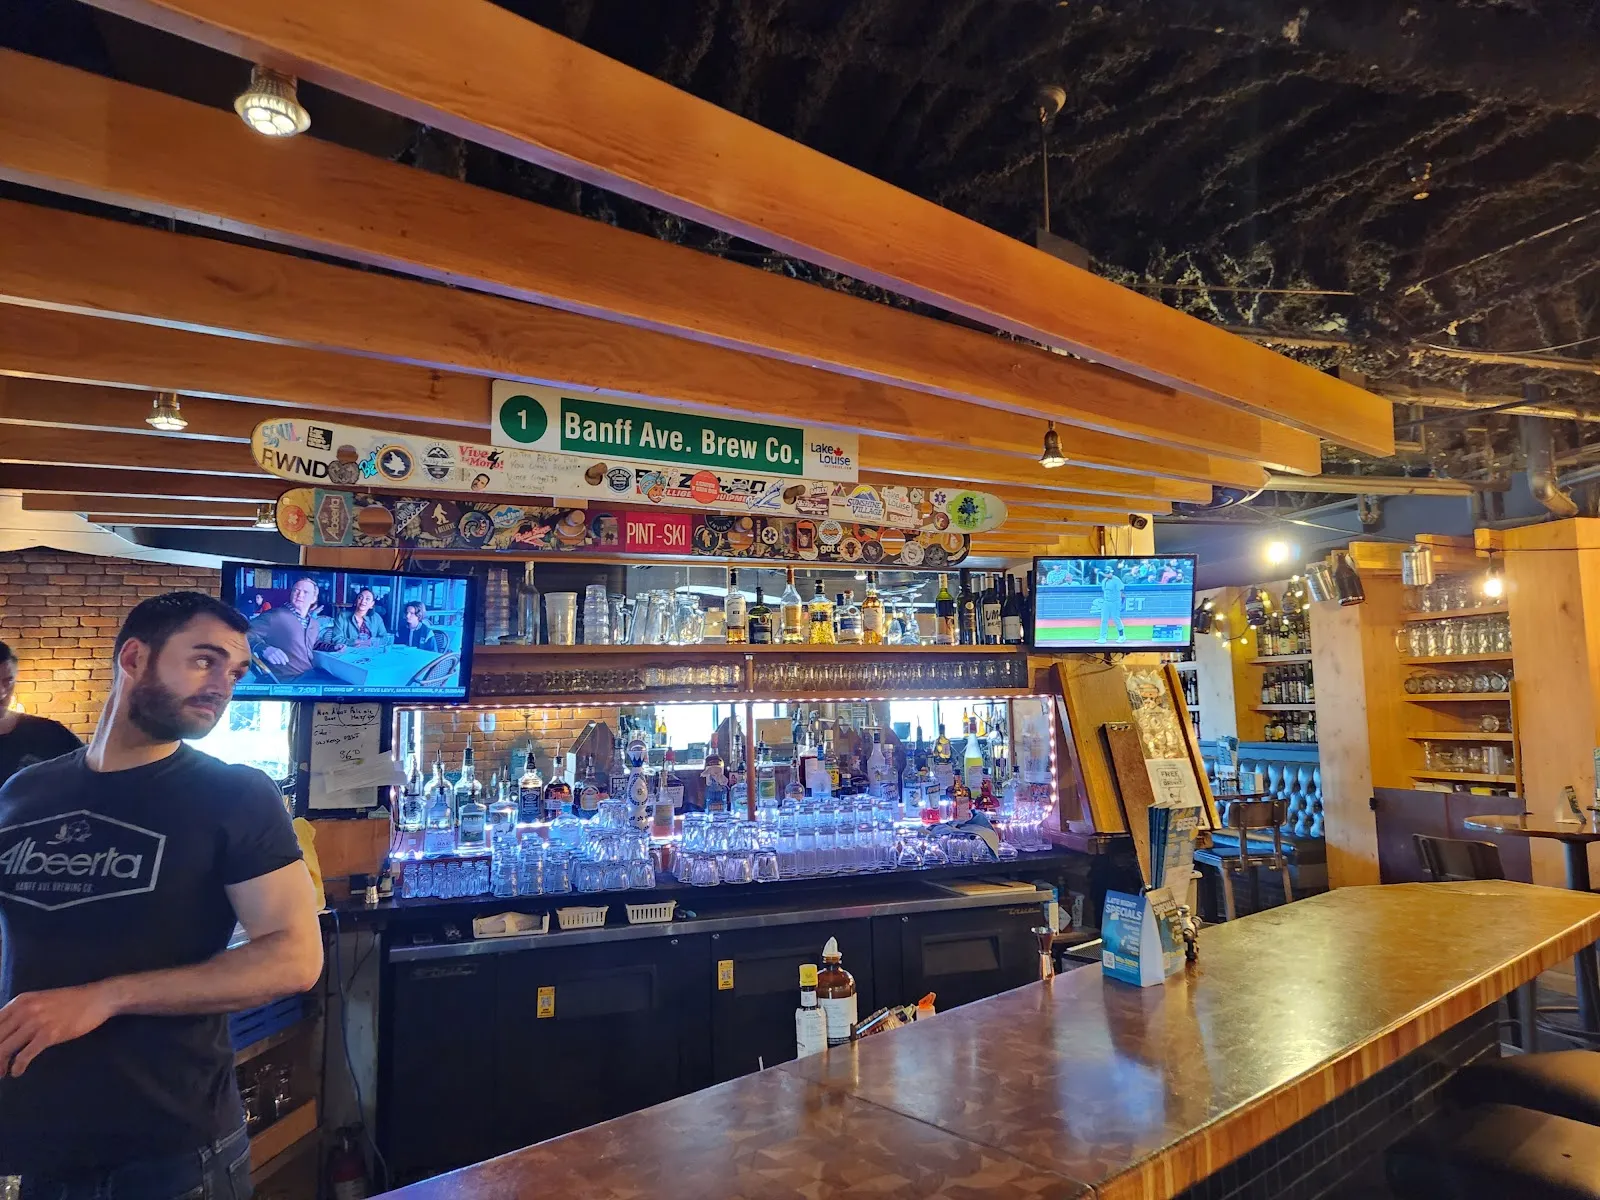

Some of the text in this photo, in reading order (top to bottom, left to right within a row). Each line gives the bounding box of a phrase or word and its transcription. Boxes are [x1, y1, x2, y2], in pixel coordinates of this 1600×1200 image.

[517, 409, 527, 430] 1
[565, 411, 800, 465] Banff Ave. Brew Co.
[458, 445, 489, 459] Vive
[810, 442, 834, 455] Lake
[819, 453, 851, 466] Louise
[298, 686, 317, 694] 7:09
[0, 836, 143, 879] Albeerta
[1105, 903, 1142, 921] SPECIALS
